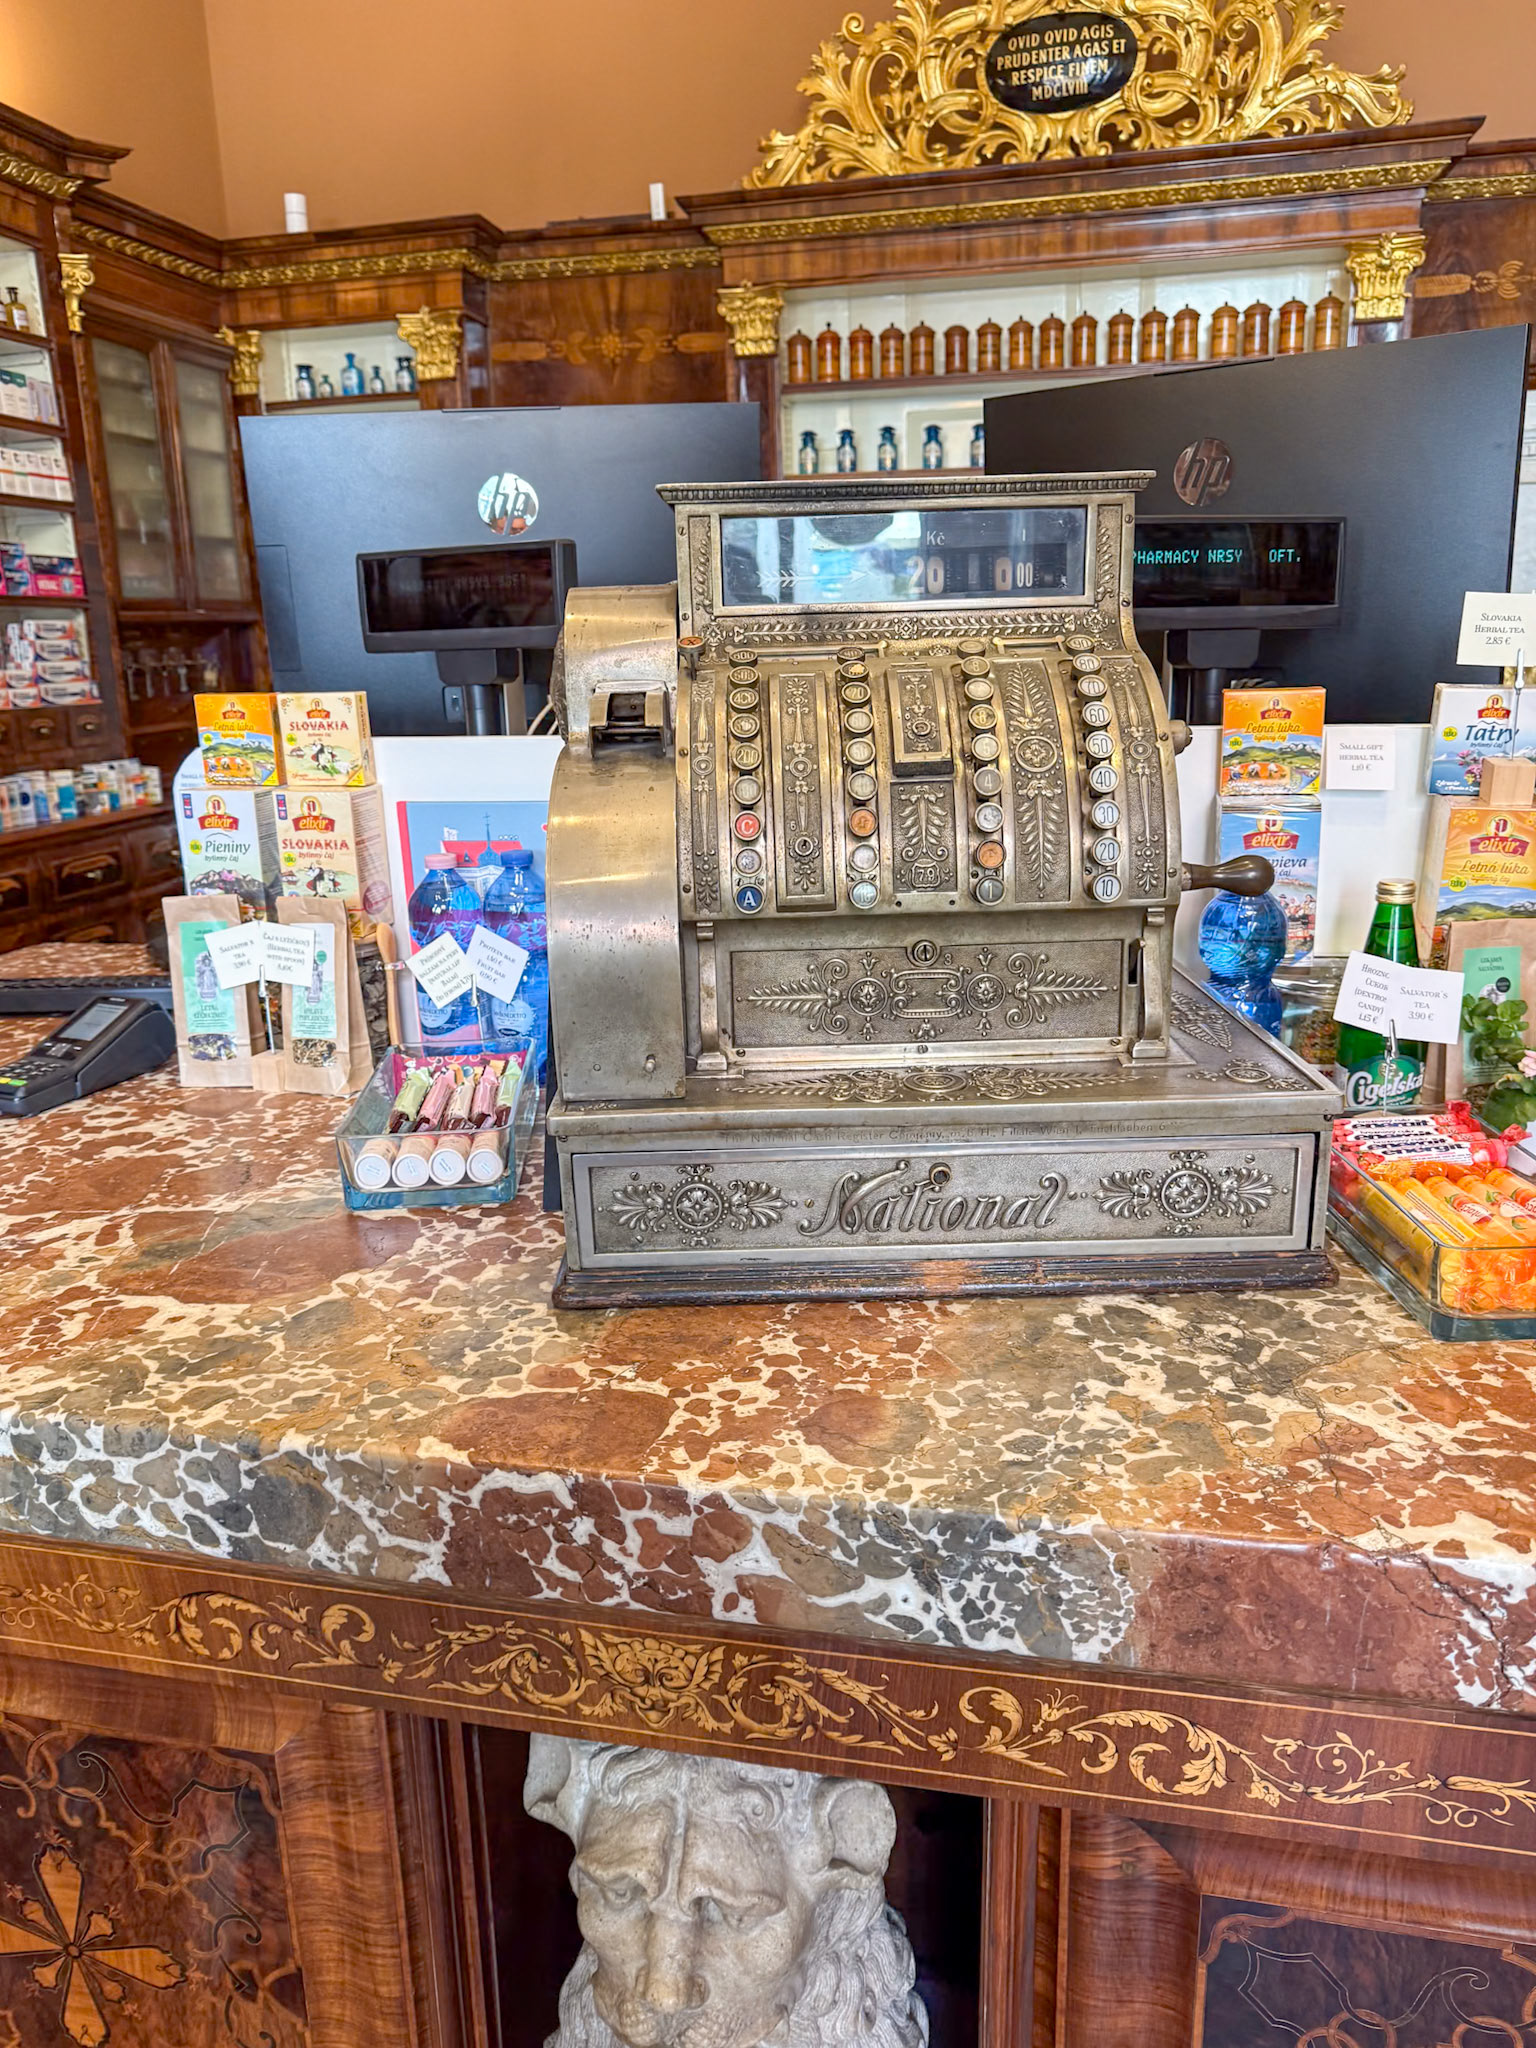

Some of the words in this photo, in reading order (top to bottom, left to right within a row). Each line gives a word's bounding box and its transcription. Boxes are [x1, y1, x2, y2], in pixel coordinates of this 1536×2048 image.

[1044, 28, 1077, 45] QVID
[1080, 24, 1114, 40] AGIS
[996, 45, 1070, 71] PRUDENTER
[1073, 40, 1109, 58] AGAS
[1113, 39, 1126, 53] ET
[1011, 65, 1065, 86] RESPICE
[1068, 58, 1108, 77] FINEM
[478, 472, 539, 535] hp
[1208, 550, 1243, 563] NRSY
[1080, 659, 1095, 670] 80
[1085, 681, 1100, 694] 70
[1089, 708, 1105, 723] 60
[289, 721, 349, 731] SLOVAKIA
[1245, 722, 1275, 733] Letná
[1465, 724, 1520, 744] Tatry
[1092, 738, 1109, 754] 50
[984, 774, 993, 790] 4
[1096, 770, 1111, 788] 40
[204, 815, 234, 830] elixir
[1098, 806, 1114, 824] 30
[299, 816, 330, 831] elixir
[742, 820, 754, 834] C
[205, 840, 251, 855] Pieniny
[282, 839, 350, 850] SLOVAKIA
[1252, 834, 1291, 848] elixir
[1478, 838, 1520, 855] elixir
[1100, 842, 1115, 860] 20
[1460, 860, 1498, 873] Letná
[1500, 862, 1529, 874] lúka
[917, 868, 935, 882] 79
[1102, 879, 1114, 897] 10
[743, 891, 756, 906] A
[838, 1132, 884, 1143] Register
[797, 1159, 1068, 1237] National
